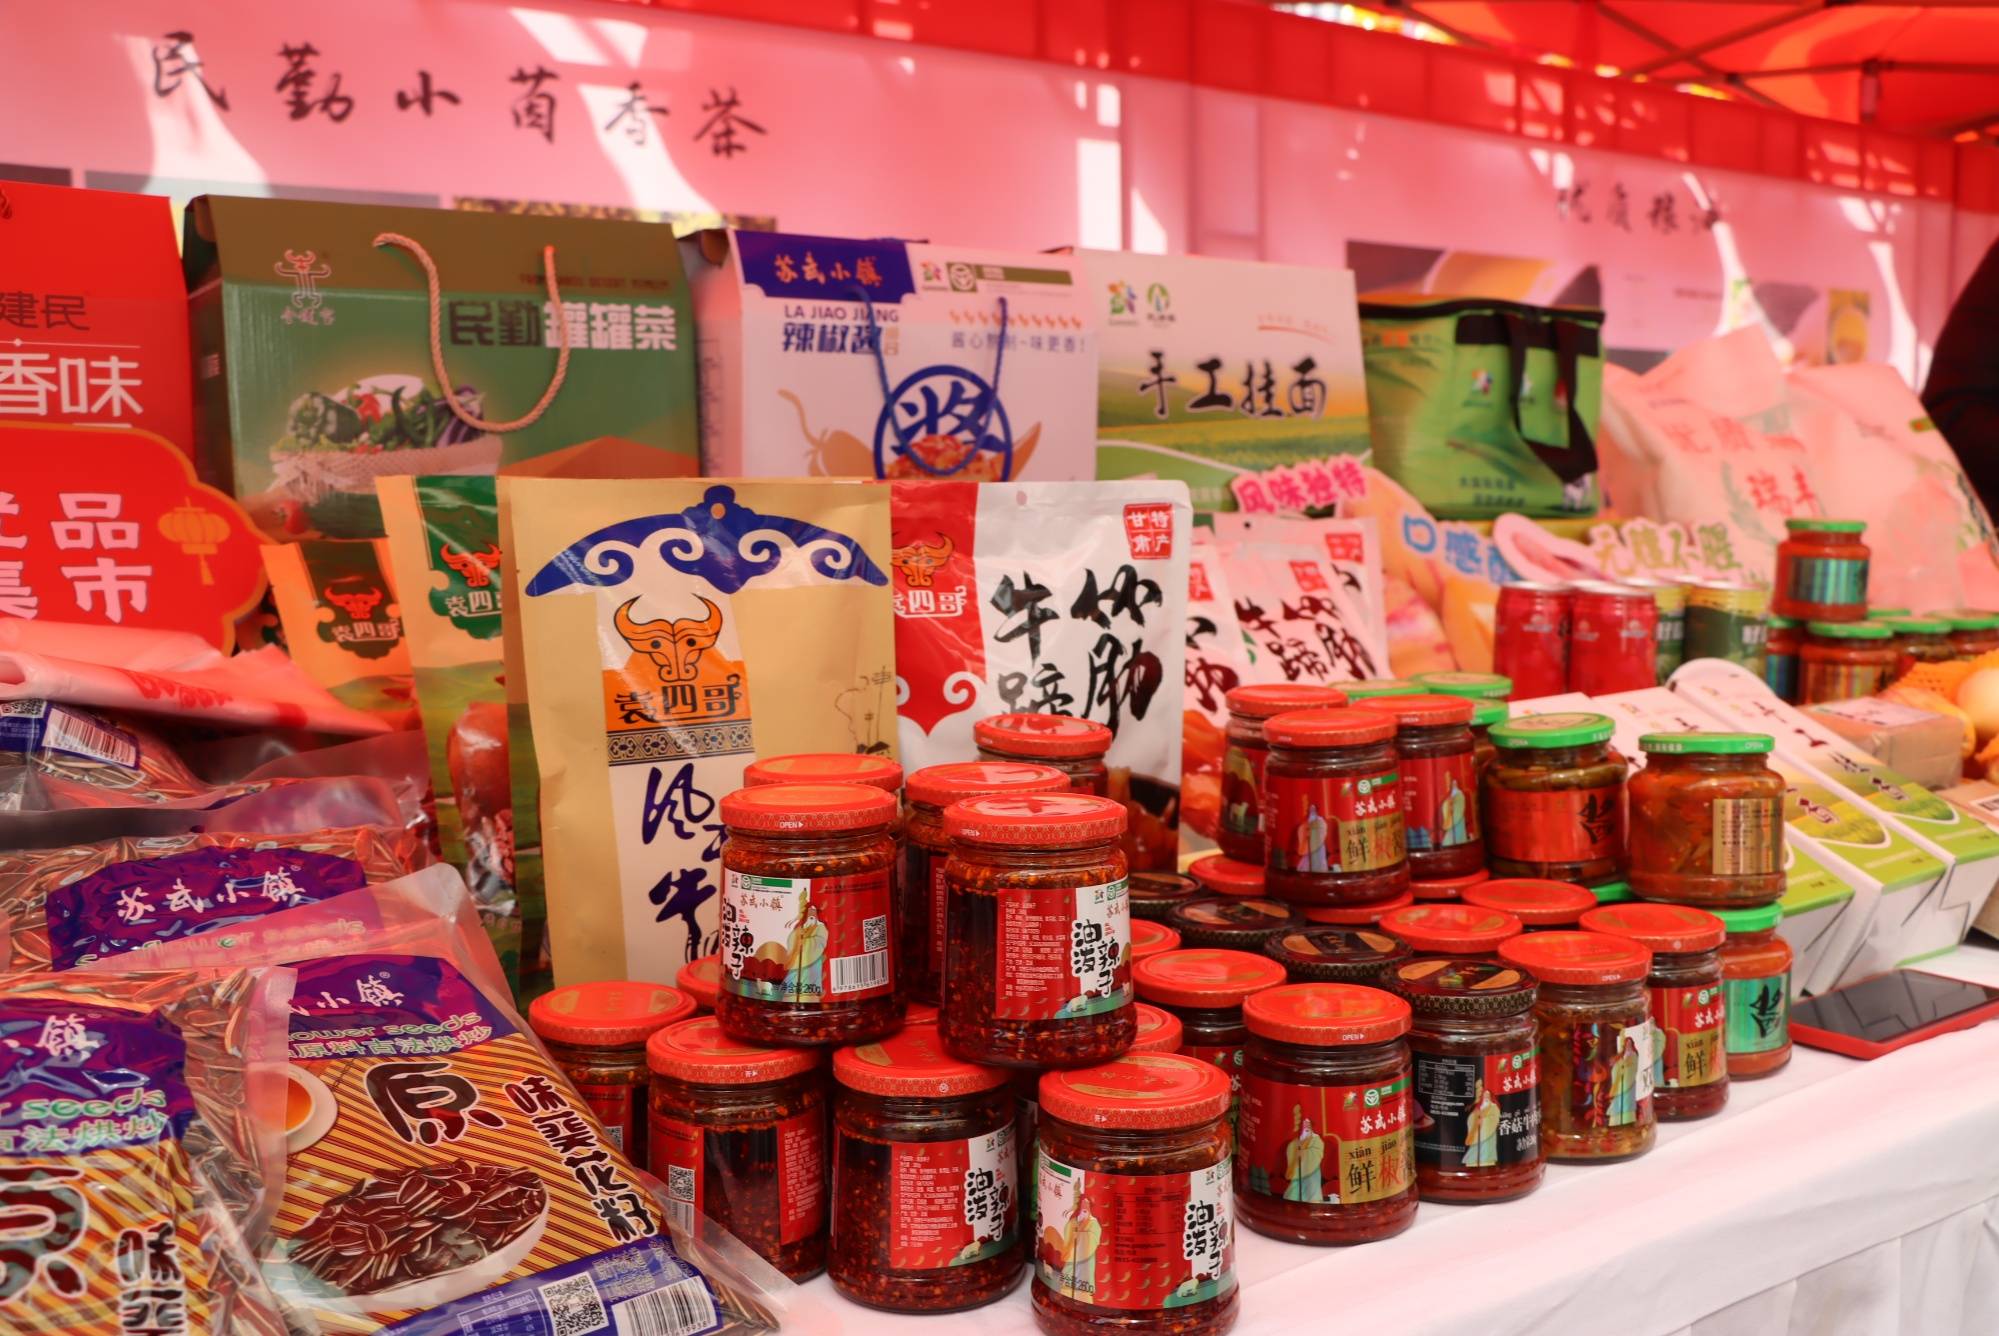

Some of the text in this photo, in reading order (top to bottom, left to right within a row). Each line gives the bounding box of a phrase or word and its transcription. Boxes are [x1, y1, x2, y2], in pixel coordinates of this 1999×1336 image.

[153, 32, 767, 158] 民勤小茴香茶
[448, 300, 677, 351] 民勤罐罐菜
[784, 304, 805, 319] LA
[812, 305, 847, 321] JIAO
[1139, 351, 1327, 417] 手工挂面
[614, 673, 743, 725] 袁四哥
[117, 866, 308, 923] 苏武小镇
[384, 1012, 482, 1036] seeds
[22, 1086, 167, 1120] seeds
